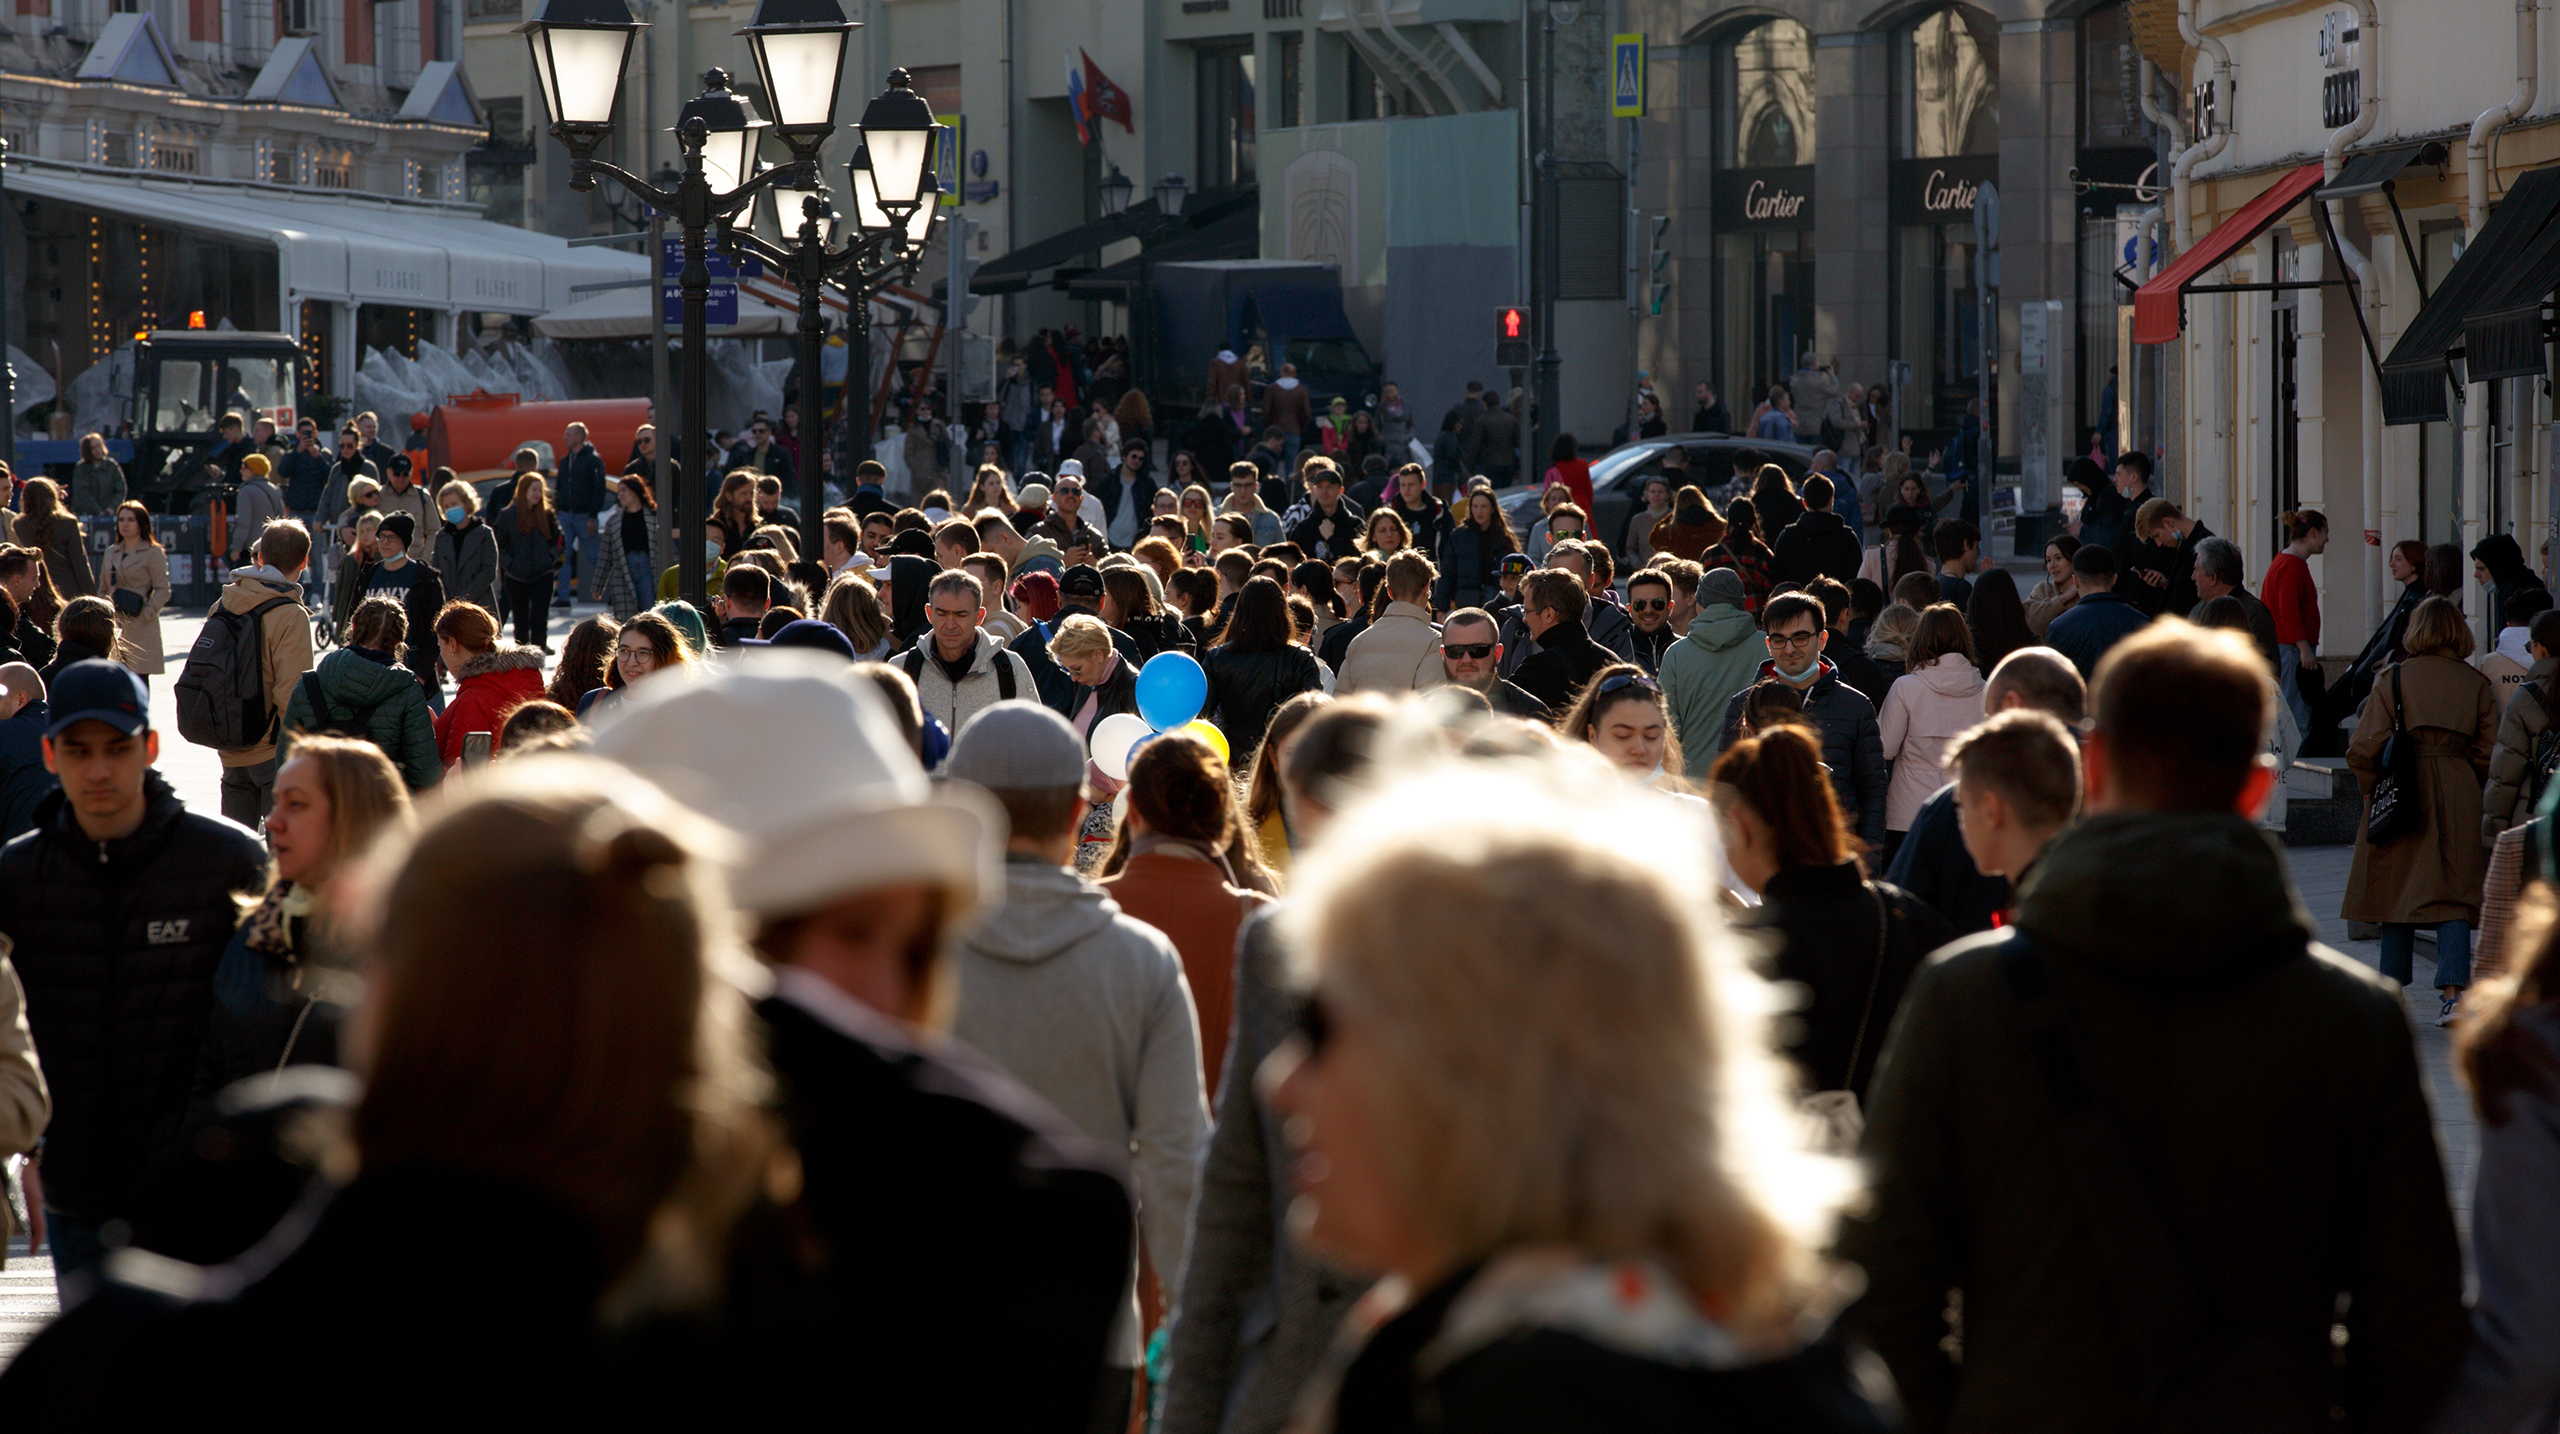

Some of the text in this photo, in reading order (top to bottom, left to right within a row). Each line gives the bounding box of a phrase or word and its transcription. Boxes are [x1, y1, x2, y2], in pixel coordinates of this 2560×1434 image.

[1744, 179, 1806, 220] Cartier
[1924, 168, 1978, 211] Cartie
[366, 586, 411, 602] NAVY
[147, 919, 191, 939] EA7
